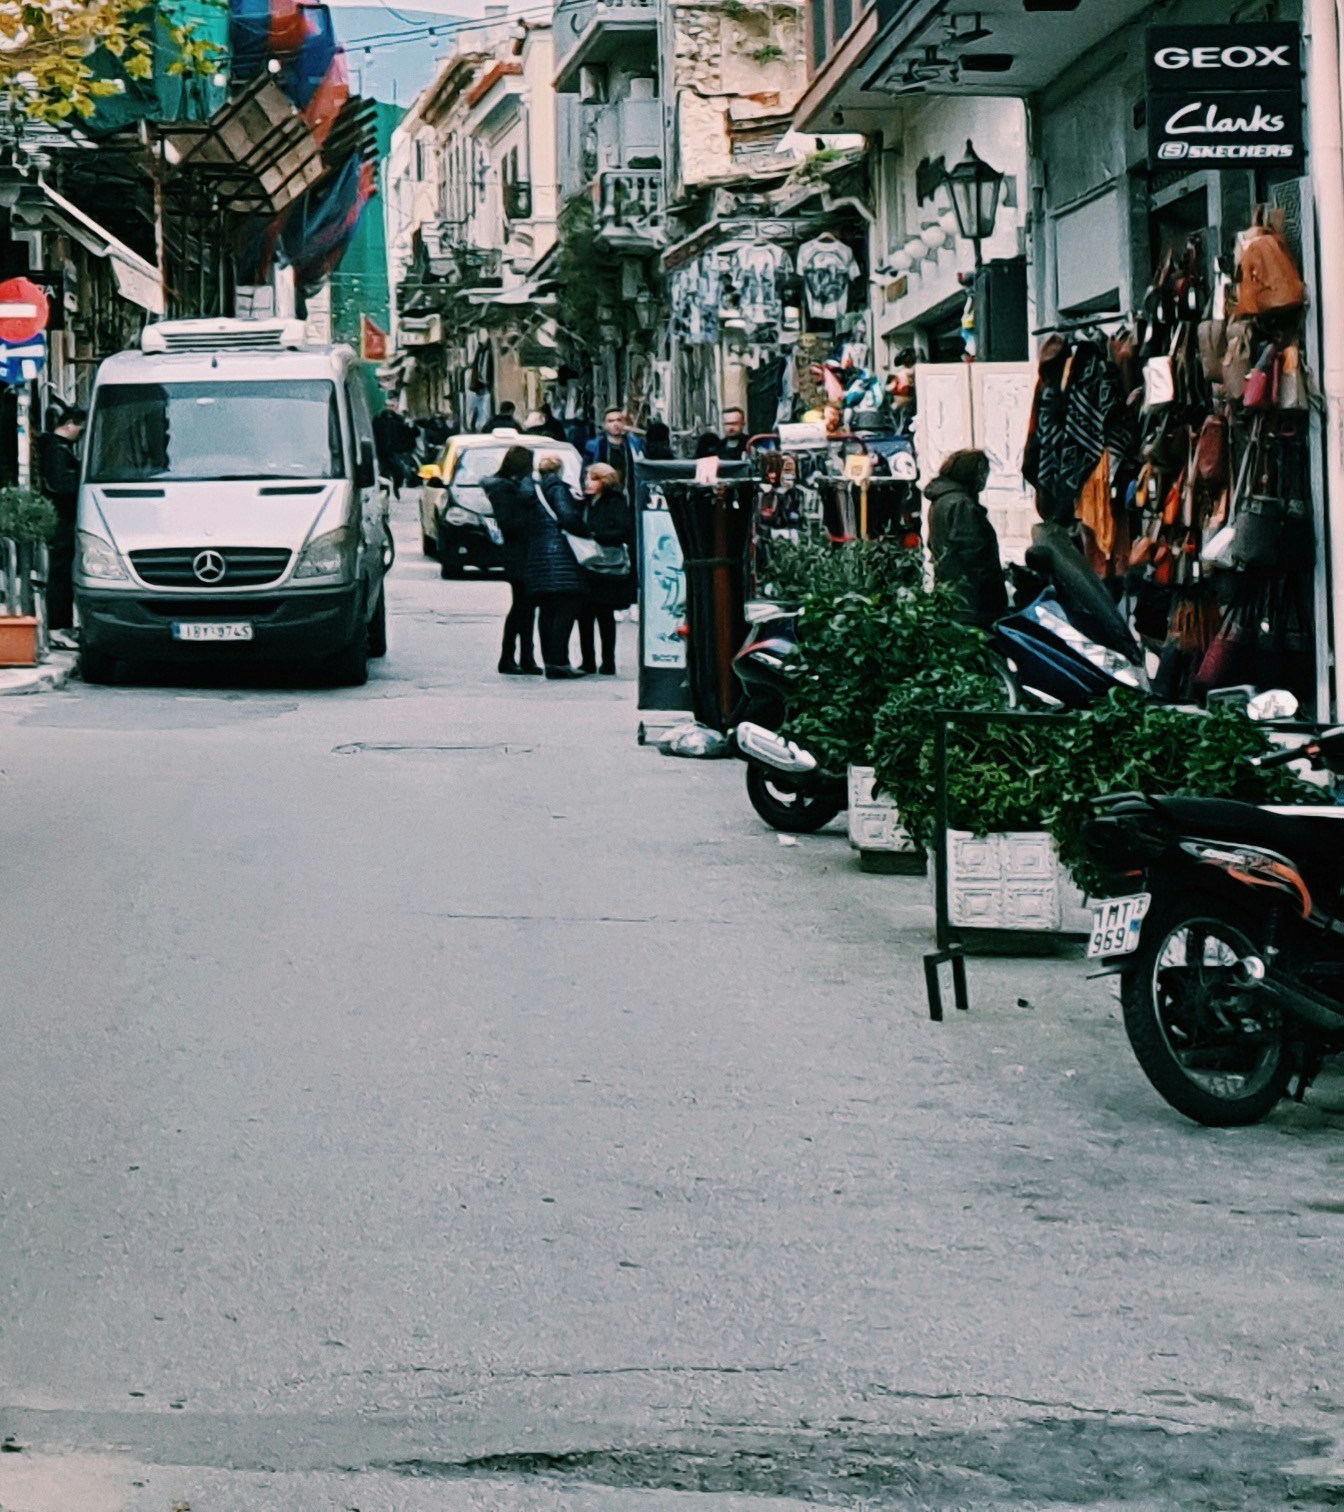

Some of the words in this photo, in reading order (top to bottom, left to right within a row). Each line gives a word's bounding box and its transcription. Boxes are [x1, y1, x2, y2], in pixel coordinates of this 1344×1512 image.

[1154, 45, 1291, 69] GEOX
[1165, 101, 1285, 135] Clarks
[1188, 144, 1293, 158] SKECHERS
[1092, 927, 1125, 954] 969
